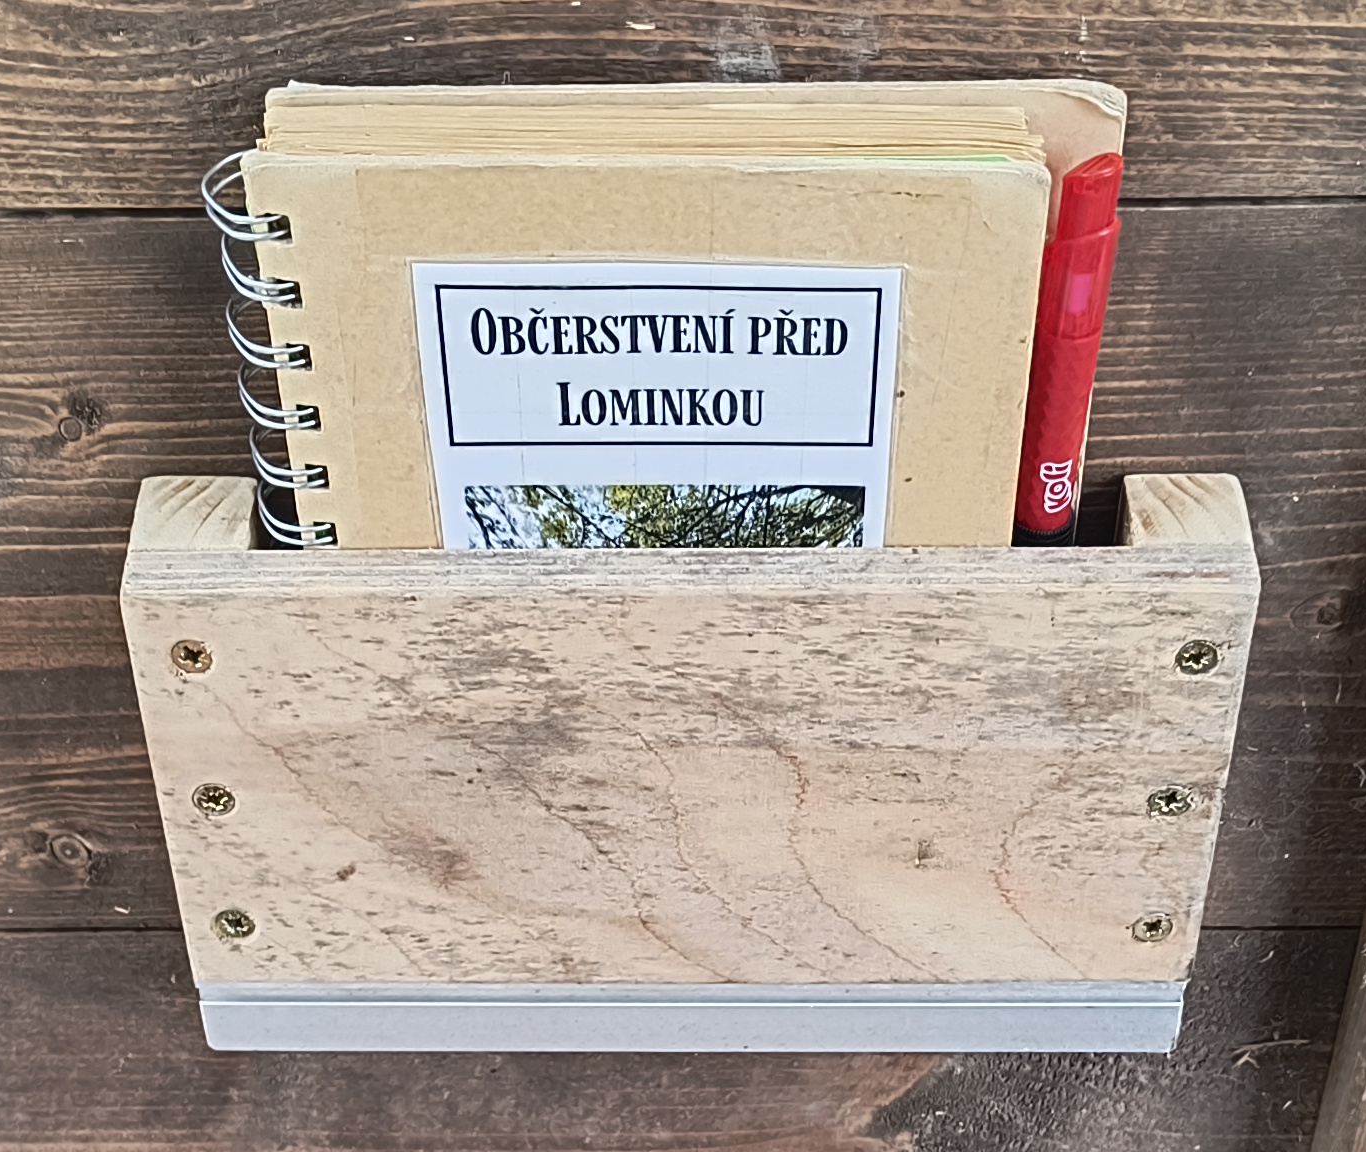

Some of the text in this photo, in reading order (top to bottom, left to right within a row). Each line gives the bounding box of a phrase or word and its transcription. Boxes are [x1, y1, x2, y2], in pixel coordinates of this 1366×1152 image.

[470, 307, 849, 357] OBČERSTVENÍ PŘED
[555, 381, 765, 427] LOMINKOU
